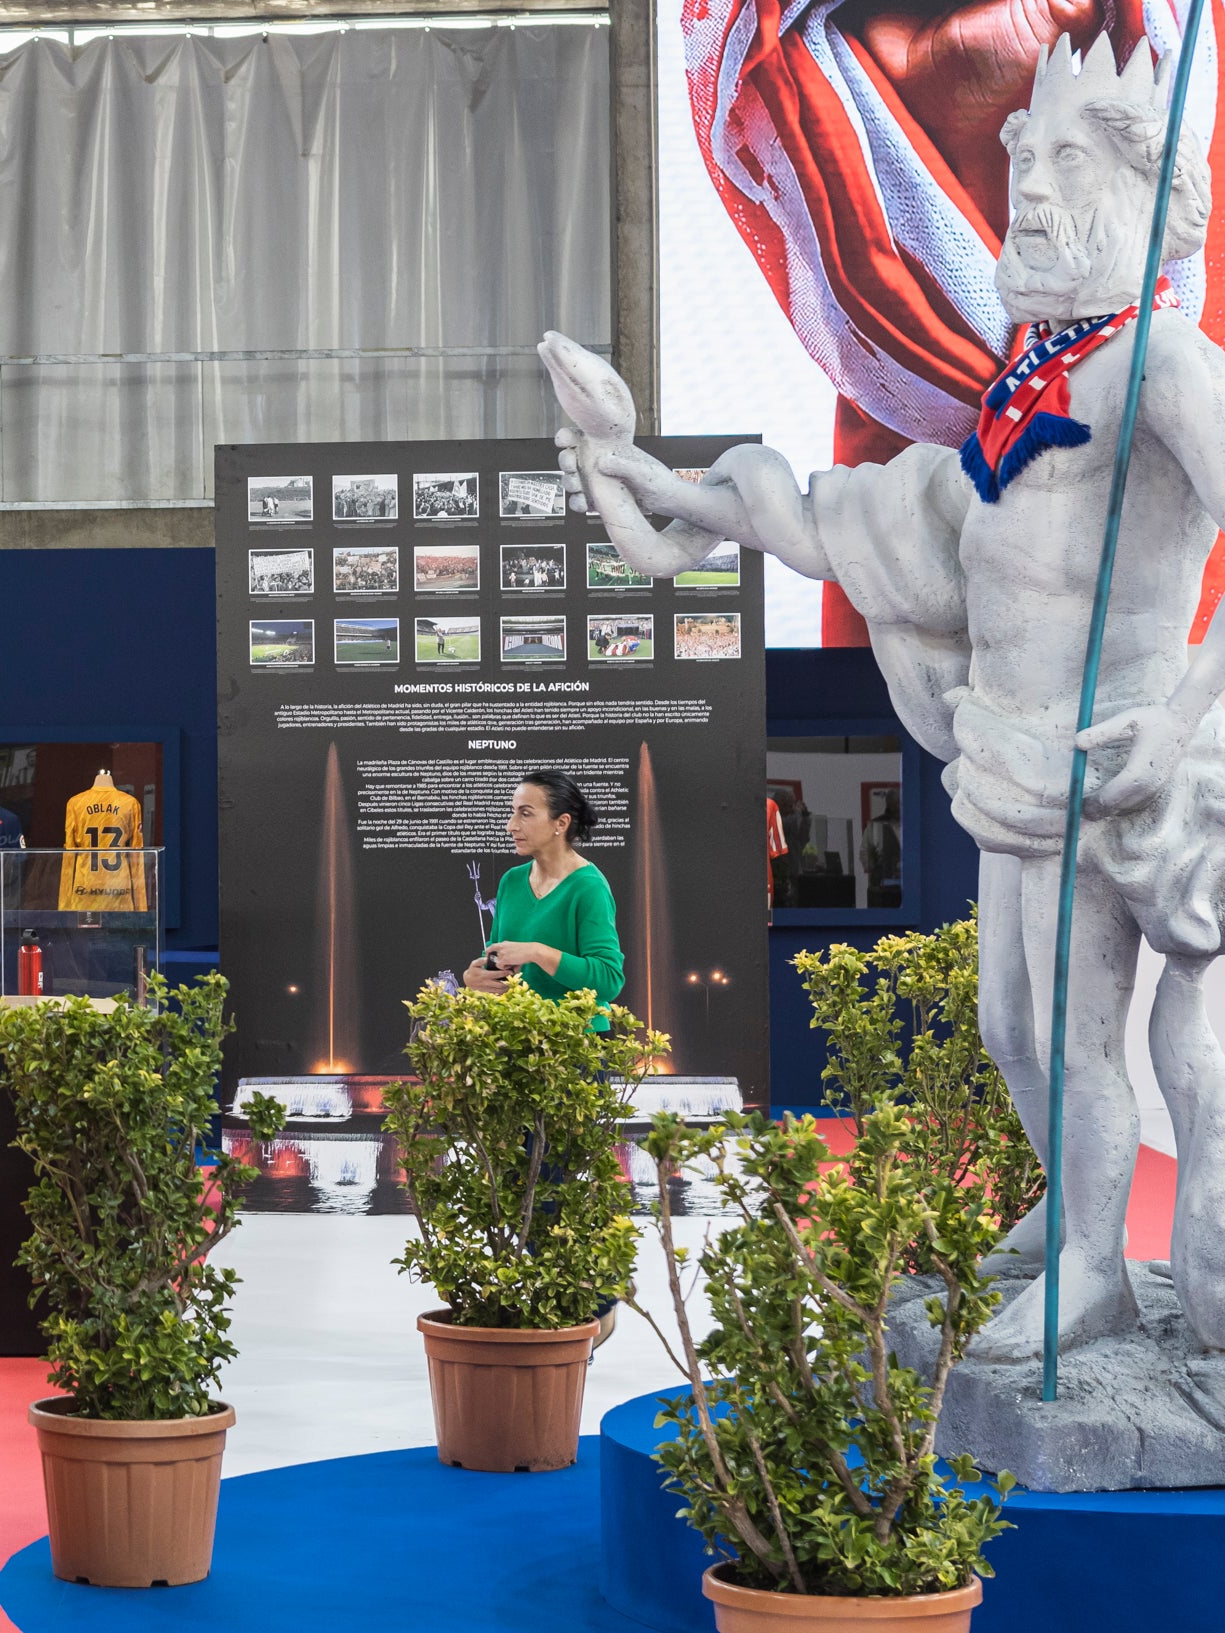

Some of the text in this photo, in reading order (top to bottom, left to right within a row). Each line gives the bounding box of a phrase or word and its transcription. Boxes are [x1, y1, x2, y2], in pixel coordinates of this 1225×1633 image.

[394, 680, 590, 693] MOMENTOS HISTÓRICOS DE LA AFICIÓN
[468, 740, 517, 749] NEPTUNO
[86, 804, 120, 815] OBLAK
[84, 826, 123, 872] 13
